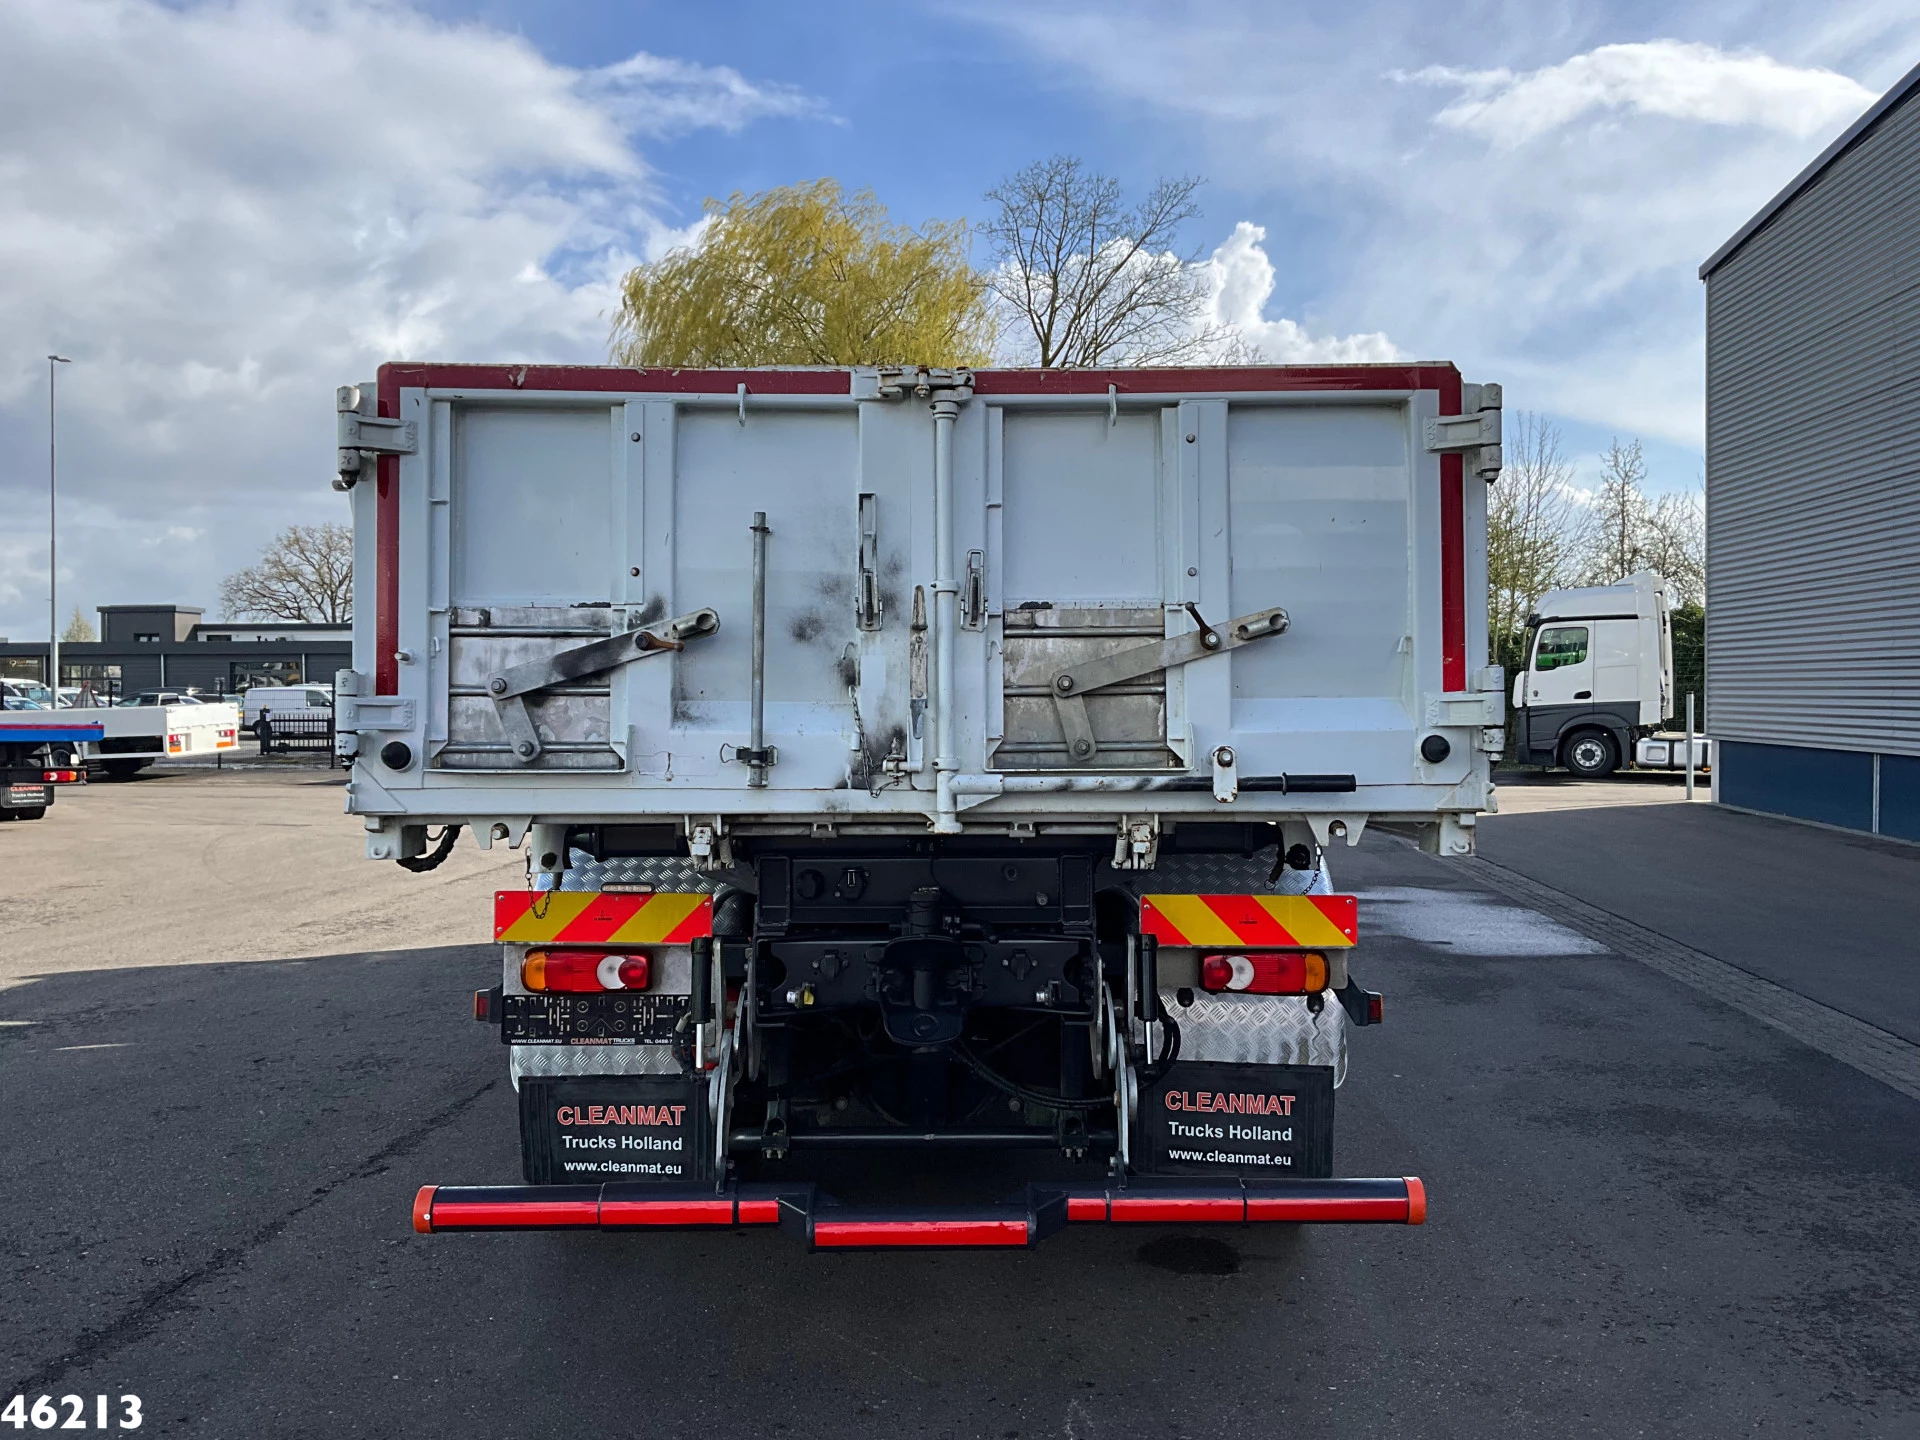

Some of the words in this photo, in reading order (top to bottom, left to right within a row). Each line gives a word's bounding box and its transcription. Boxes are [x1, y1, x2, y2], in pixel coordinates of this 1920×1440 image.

[1164, 1090, 1296, 1116] CLEANMAT
[557, 1105, 686, 1126] CLEANMAT
[1168, 1121, 1224, 1139] Trucks
[1229, 1125, 1292, 1141] Holland
[562, 1135, 617, 1149] Trucks
[621, 1135, 683, 1151] Holland
[1168, 1149, 1292, 1166] www.cleanmat.eu
[563, 1160, 682, 1175] www.cleanmat.eu
